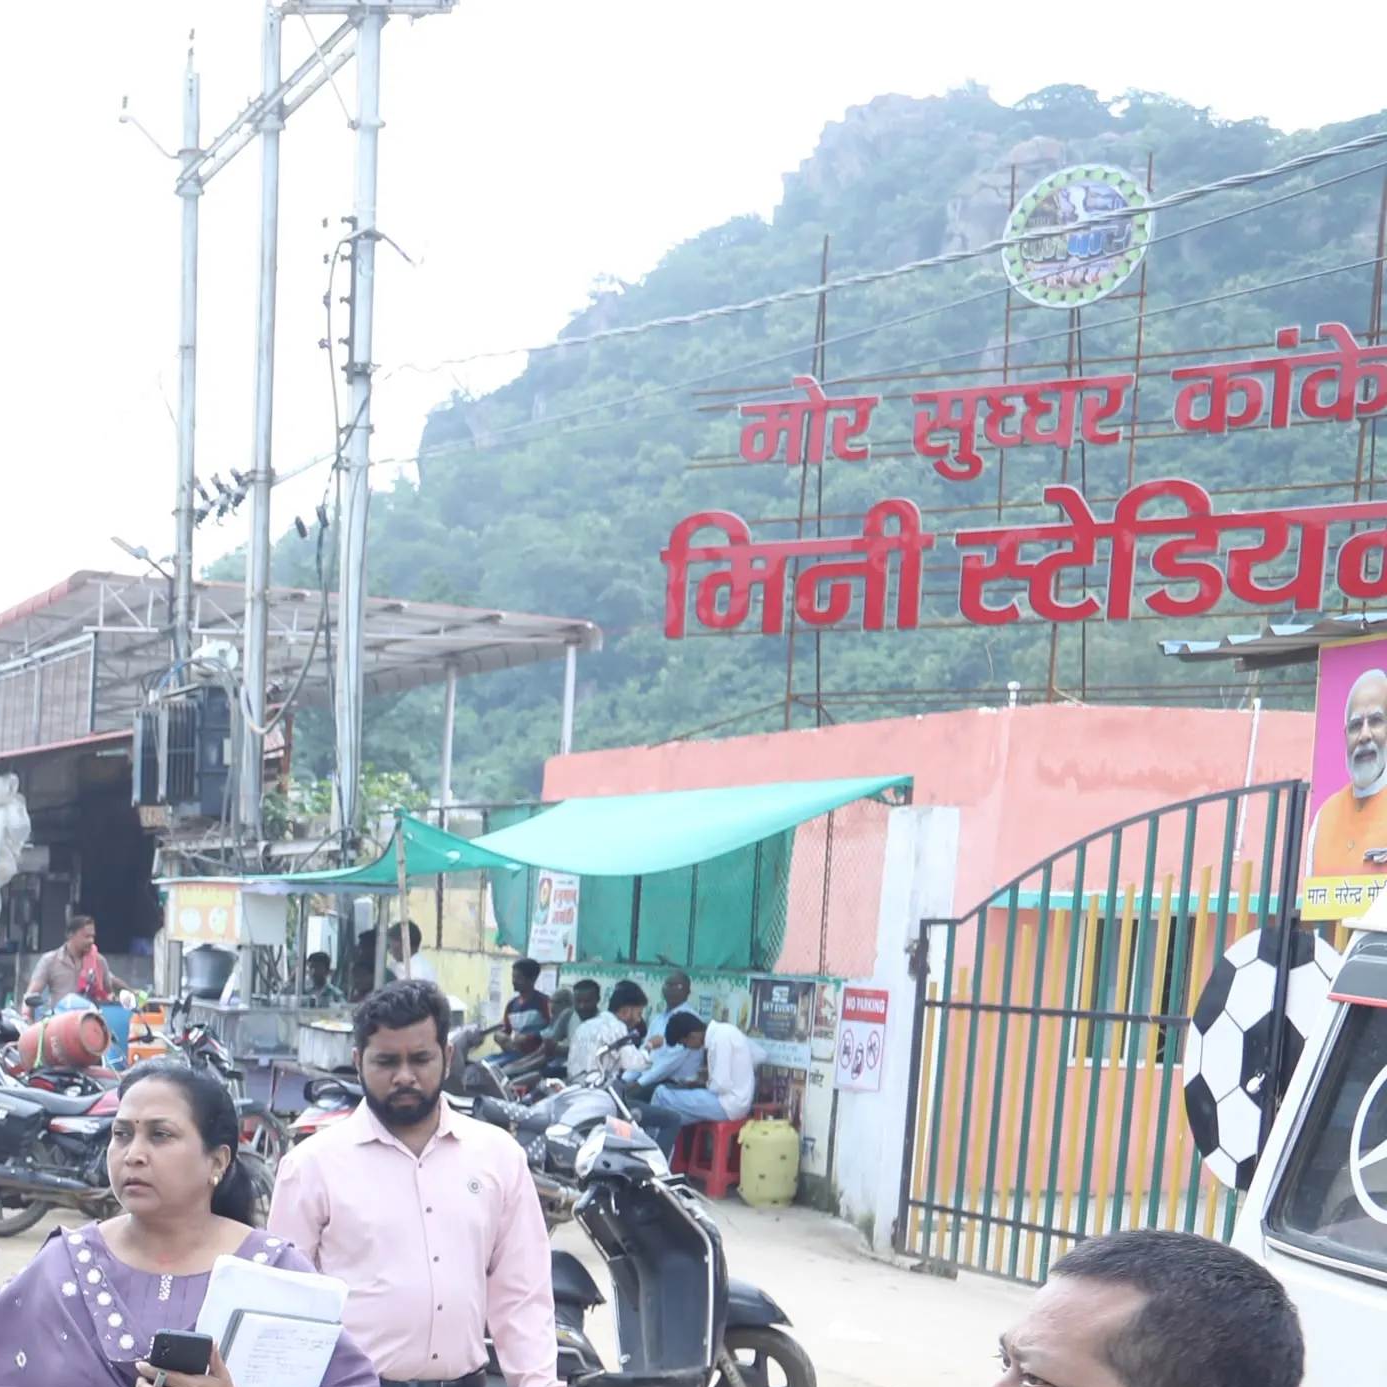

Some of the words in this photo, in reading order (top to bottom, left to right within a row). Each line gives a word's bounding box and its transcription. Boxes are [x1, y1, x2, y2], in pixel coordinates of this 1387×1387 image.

[738, 375, 881, 465] मोर
[1171, 322, 1387, 437] कांके
[660, 498, 935, 640] मिनी
[1335, 880, 1363, 905] नरेन्द्र
[1367, 879, 1387, 903] मो
[846, 995, 856, 1011] NO
[856, 996, 886, 1014] PARKING
